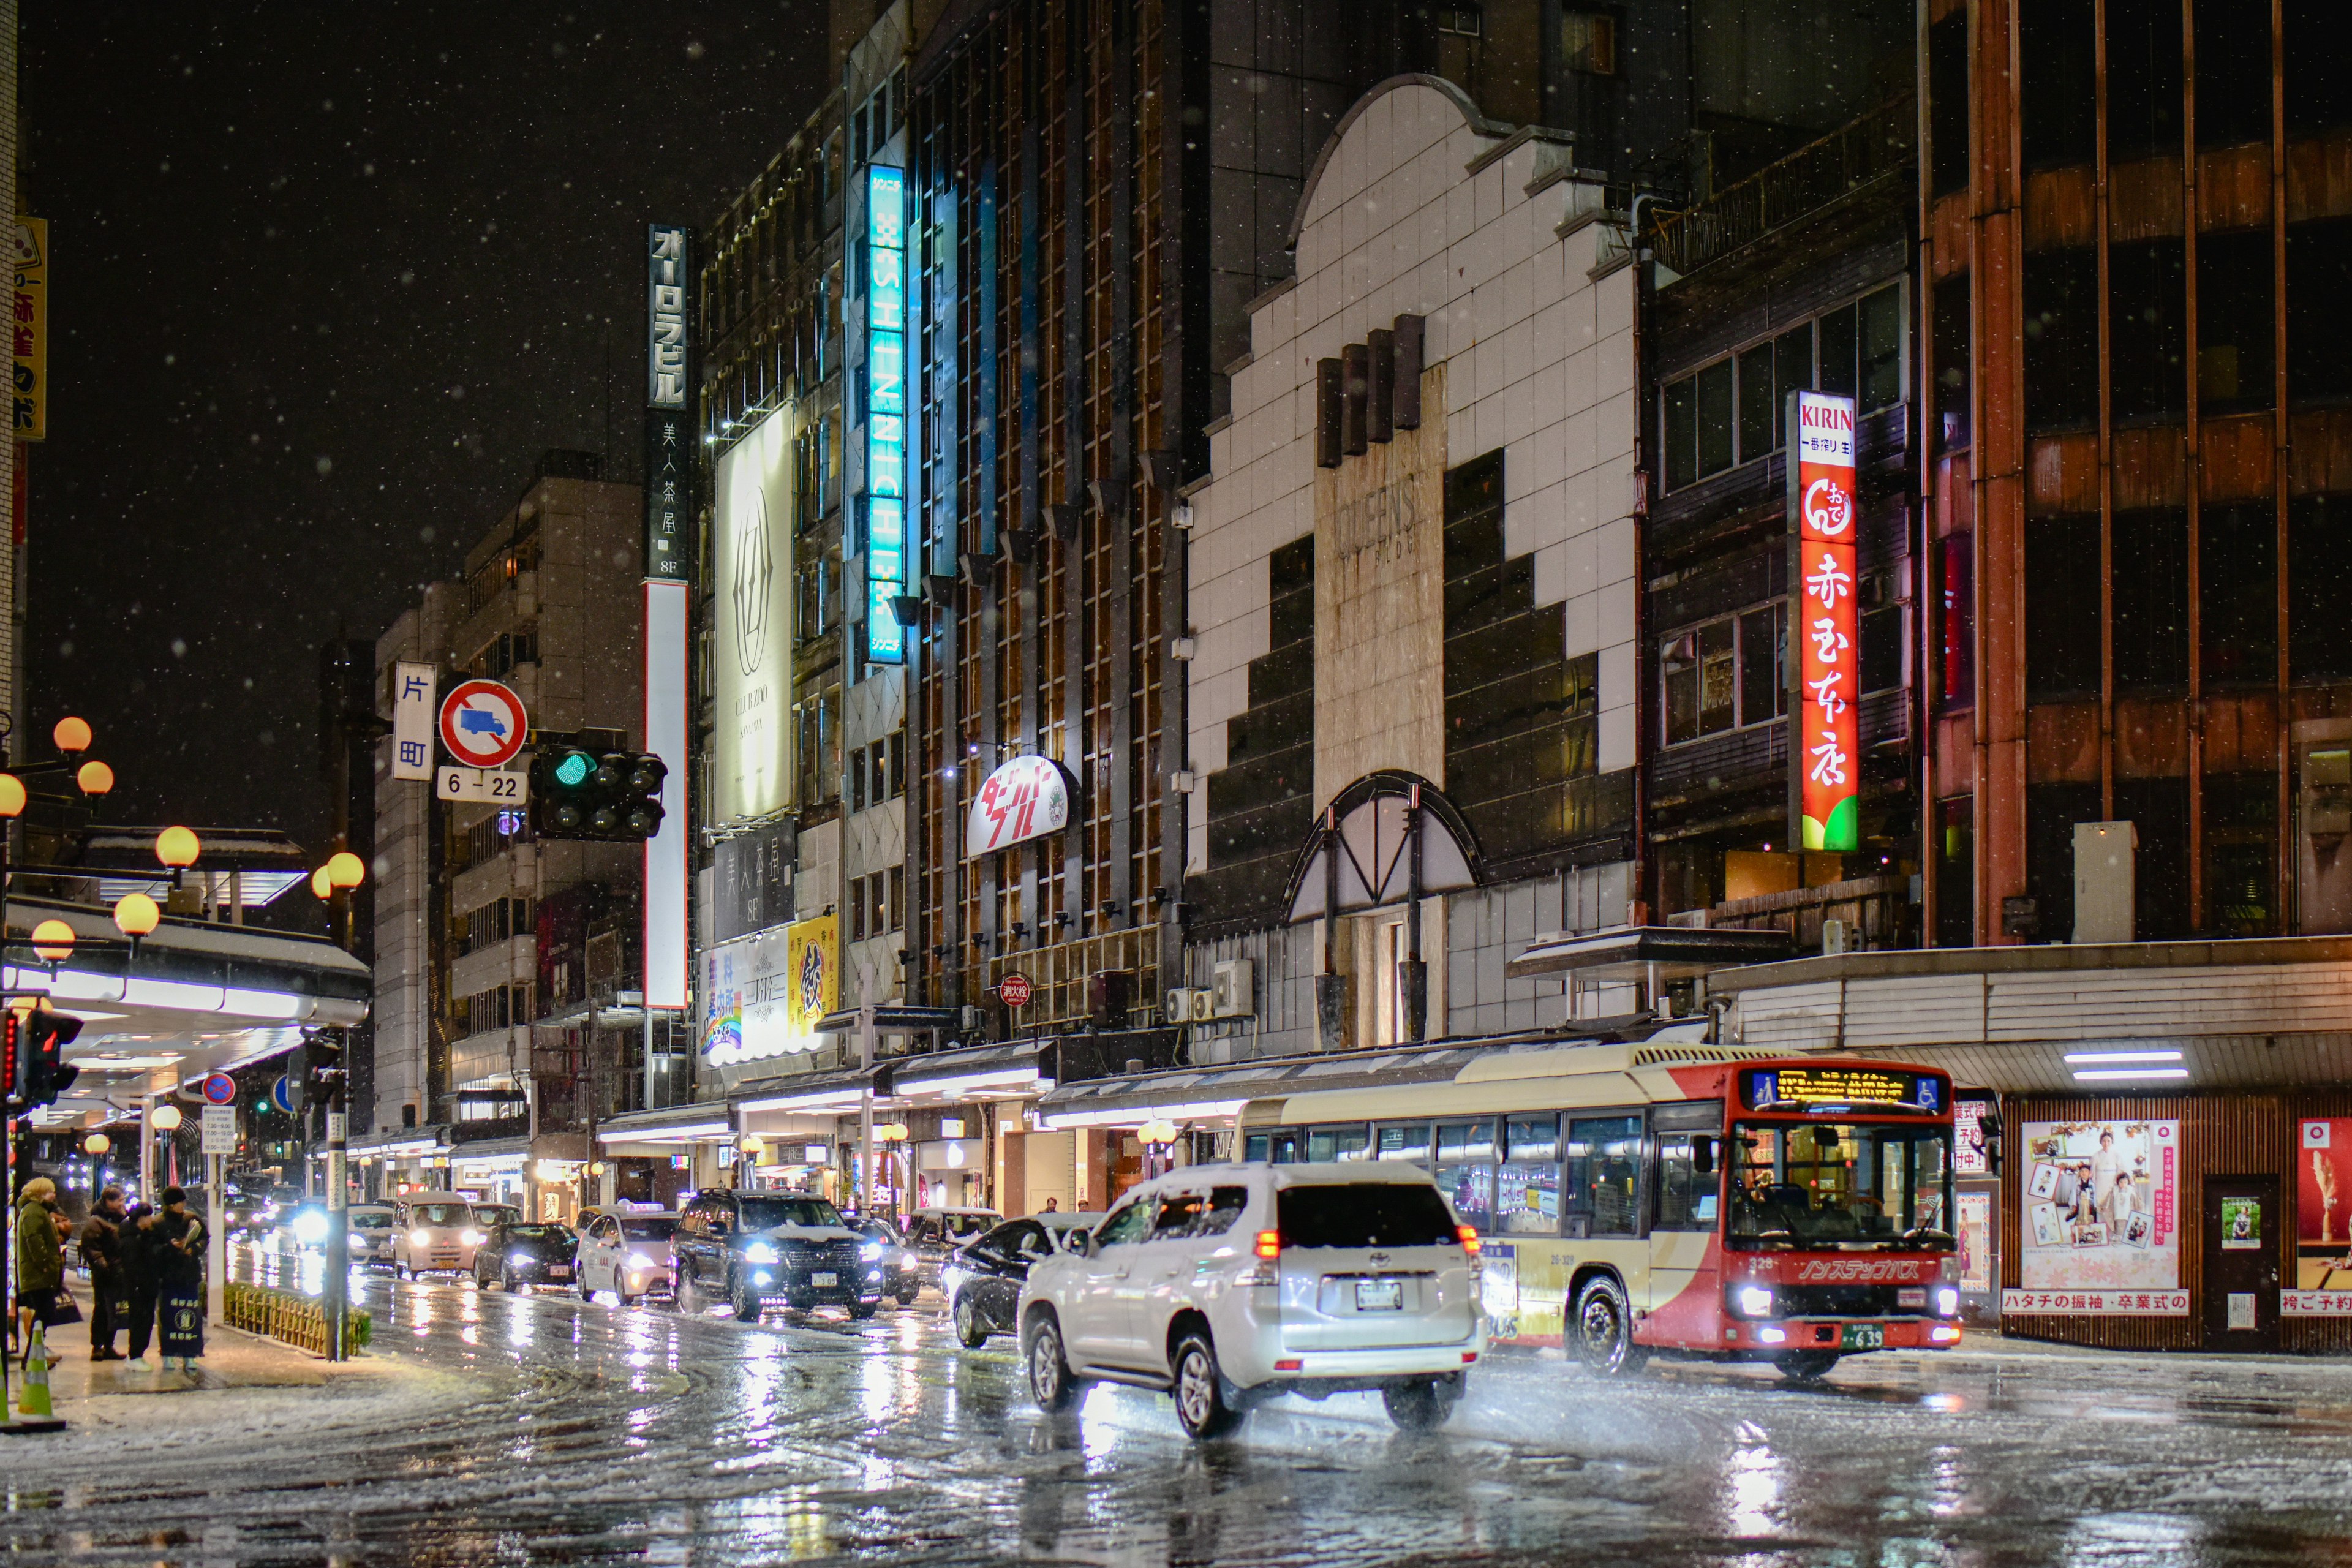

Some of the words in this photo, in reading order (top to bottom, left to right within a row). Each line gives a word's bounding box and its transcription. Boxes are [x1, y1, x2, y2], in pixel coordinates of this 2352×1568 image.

[873, 176, 901, 192] シンニチ
[652, 229, 684, 404] オーロラビル
[873, 271, 900, 556] SHINNICHI
[1801, 404, 1852, 431] KIRIN
[662, 423, 676, 535] 美人茶屋
[1338, 473, 1415, 560] QUEENS
[660, 560, 677, 573] 8F
[872, 638, 900, 652] シンニチ
[1806, 553, 1850, 786] 赤玉本店
[400, 676, 428, 767] 片町
[987, 799, 1036, 849] ブル
[727, 837, 780, 897] 美人茶屋
[747, 897, 758, 922] 8F
[709, 951, 733, 989] 無料
[709, 987, 734, 1020] 案内所
[1003, 985, 1027, 997] 消火栓
[1749, 1257, 1773, 1270] 328
[1799, 1259, 1919, 1280] ノンステップバス
[2282, 1294, 2352, 1310] 袴ご予約
